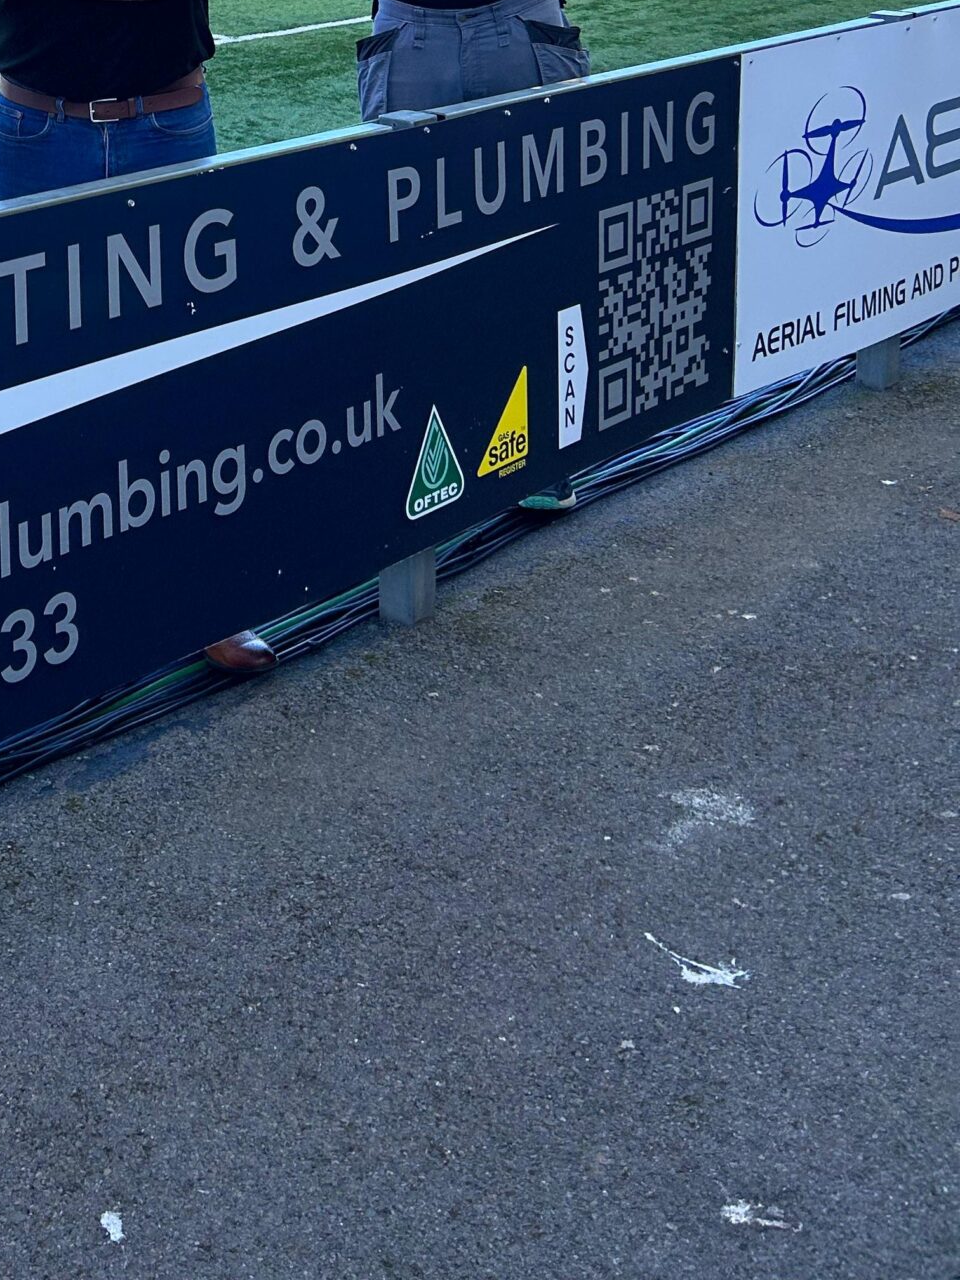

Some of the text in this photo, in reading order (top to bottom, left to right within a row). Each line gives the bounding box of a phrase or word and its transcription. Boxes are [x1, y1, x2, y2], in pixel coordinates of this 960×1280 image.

[292, 186, 341, 268] &
[387, 91, 716, 244] PLUMBING
[751, 311, 826, 362] AERIAL
[833, 278, 906, 332] FILMING
[910, 263, 944, 300] AND
[564, 325, 577, 429] SCAN
[488, 430, 527, 467] safe
[498, 431, 510, 443] GAS
[498, 458, 527, 479] REGISTER
[414, 482, 458, 513] OFTEC
